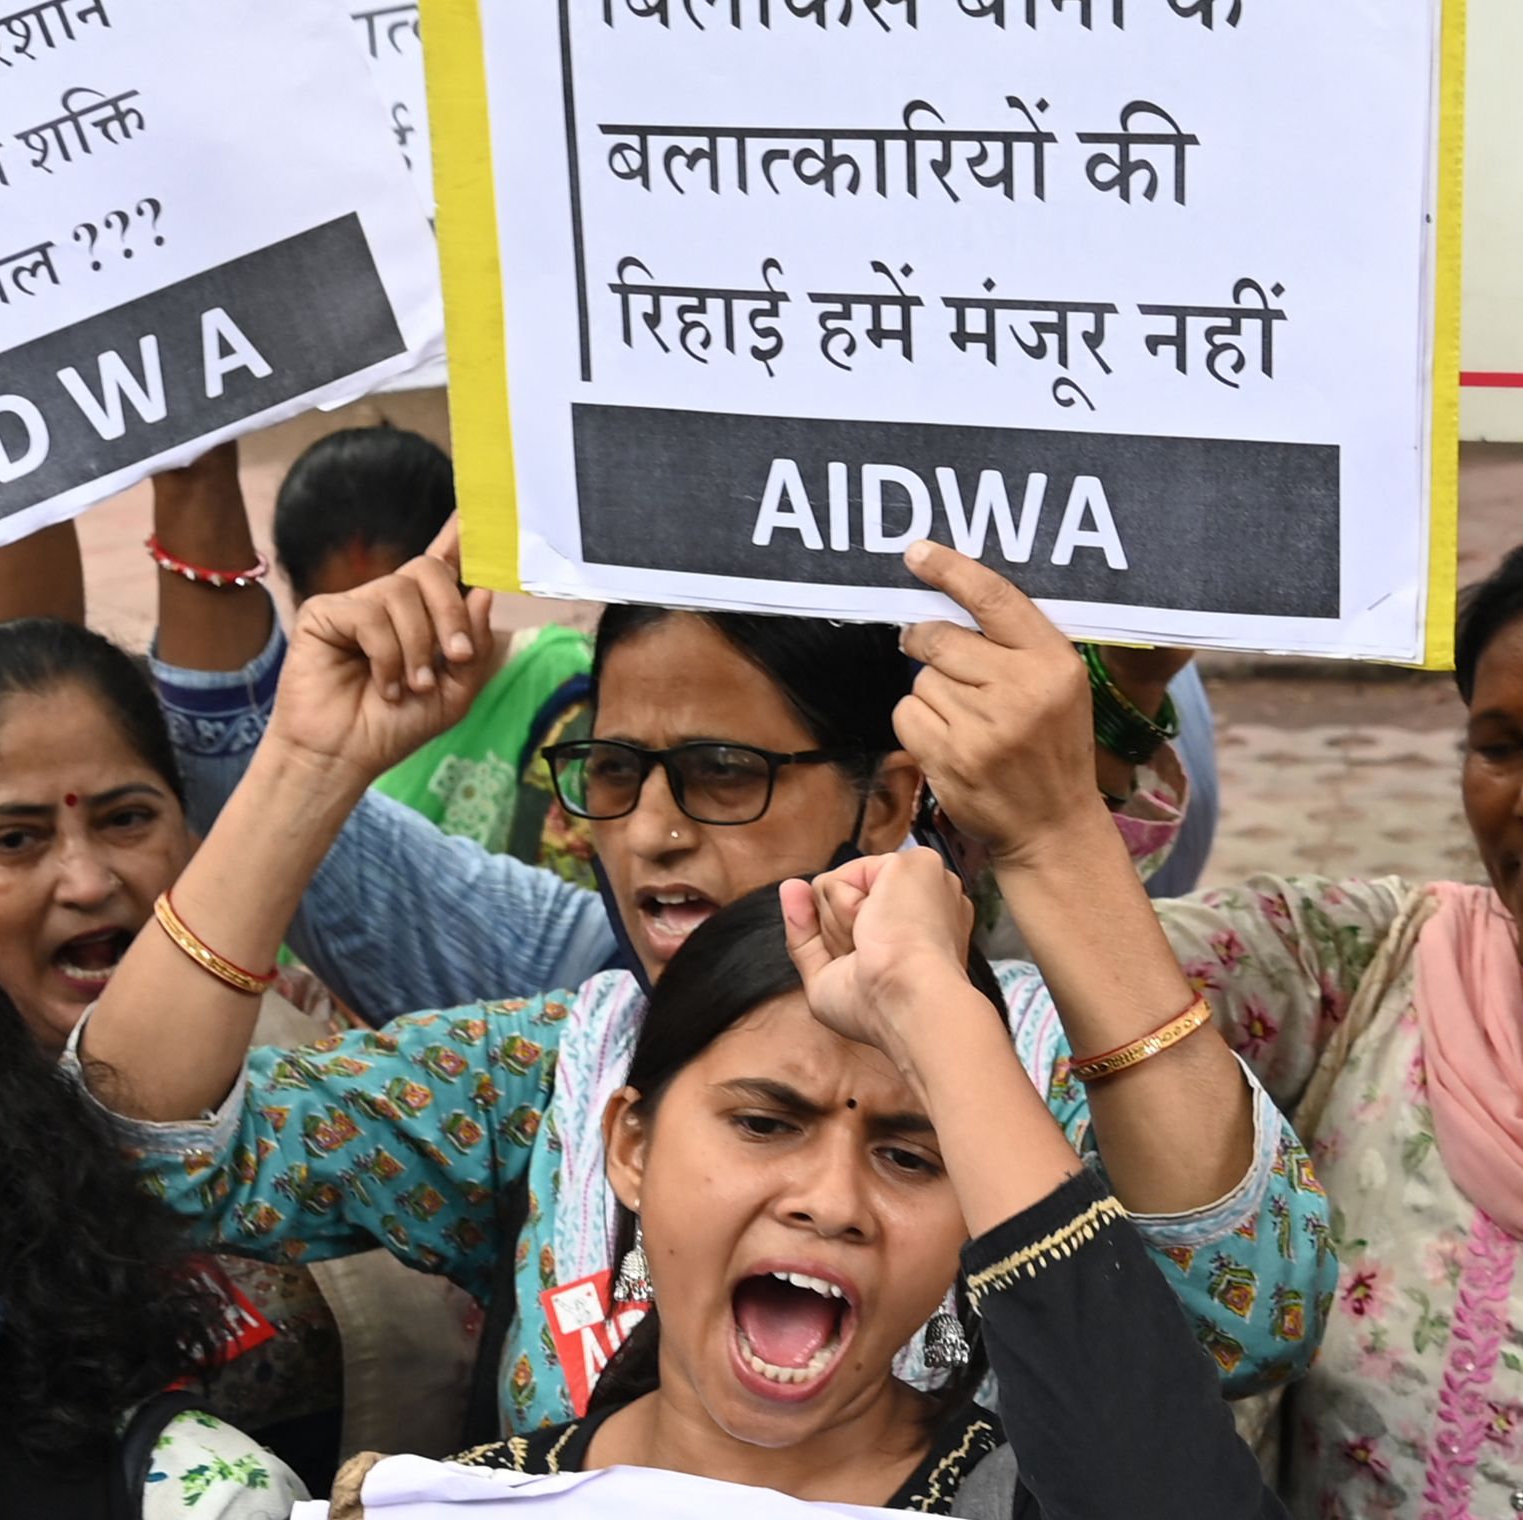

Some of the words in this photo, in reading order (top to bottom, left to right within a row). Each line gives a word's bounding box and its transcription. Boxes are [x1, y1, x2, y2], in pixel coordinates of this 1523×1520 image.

[16, 88, 143, 167] शक्ति
[598, 96, 1057, 202] बलात्कारियों
[1077, 101, 1199, 205] की
[74, 199, 163, 270] ???
[609, 257, 790, 377] रिहाई
[808, 261, 923, 370] हमें
[942, 278, 1118, 410] मंजूर
[1138, 278, 1286, 388] नहीं
[752, 459, 1128, 569] AIDWA
